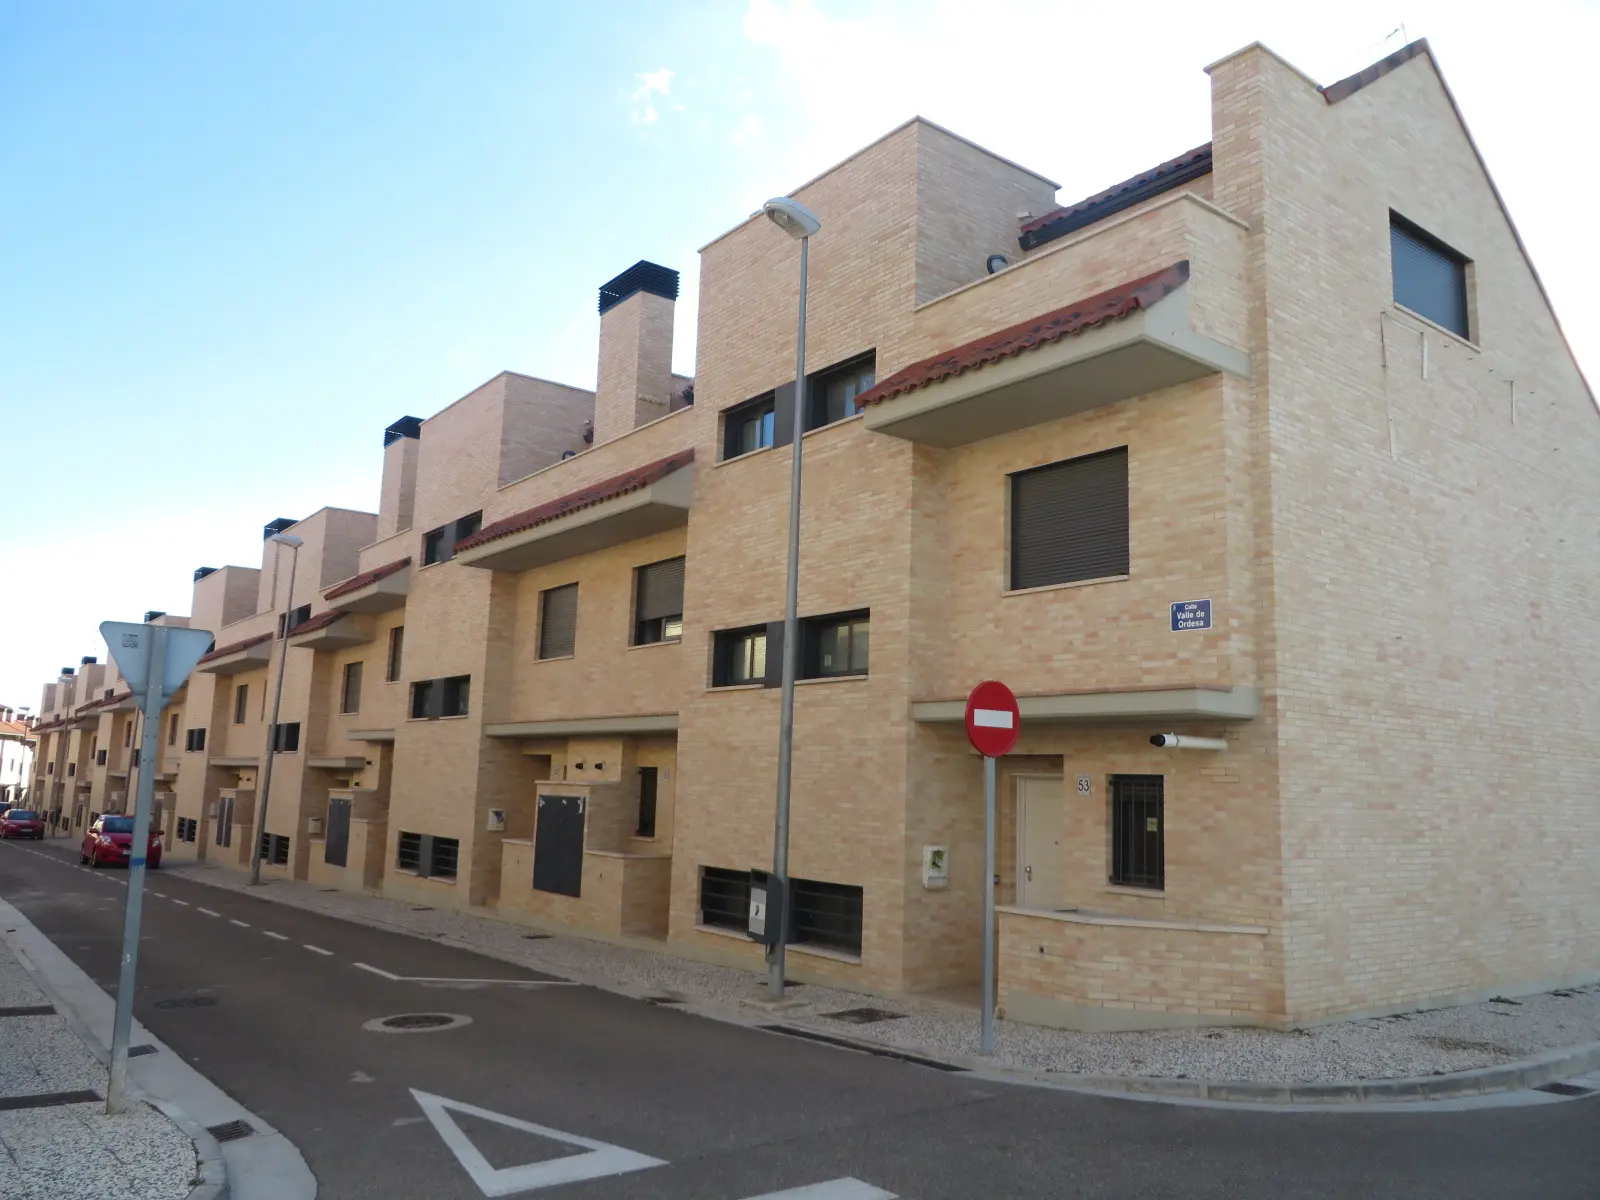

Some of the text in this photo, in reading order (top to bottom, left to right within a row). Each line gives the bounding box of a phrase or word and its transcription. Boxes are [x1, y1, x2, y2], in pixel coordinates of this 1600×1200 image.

[1176, 609, 1205, 619] Valle de
[1178, 619, 1204, 628] Ordesa
[1077, 779, 1090, 792] 53
